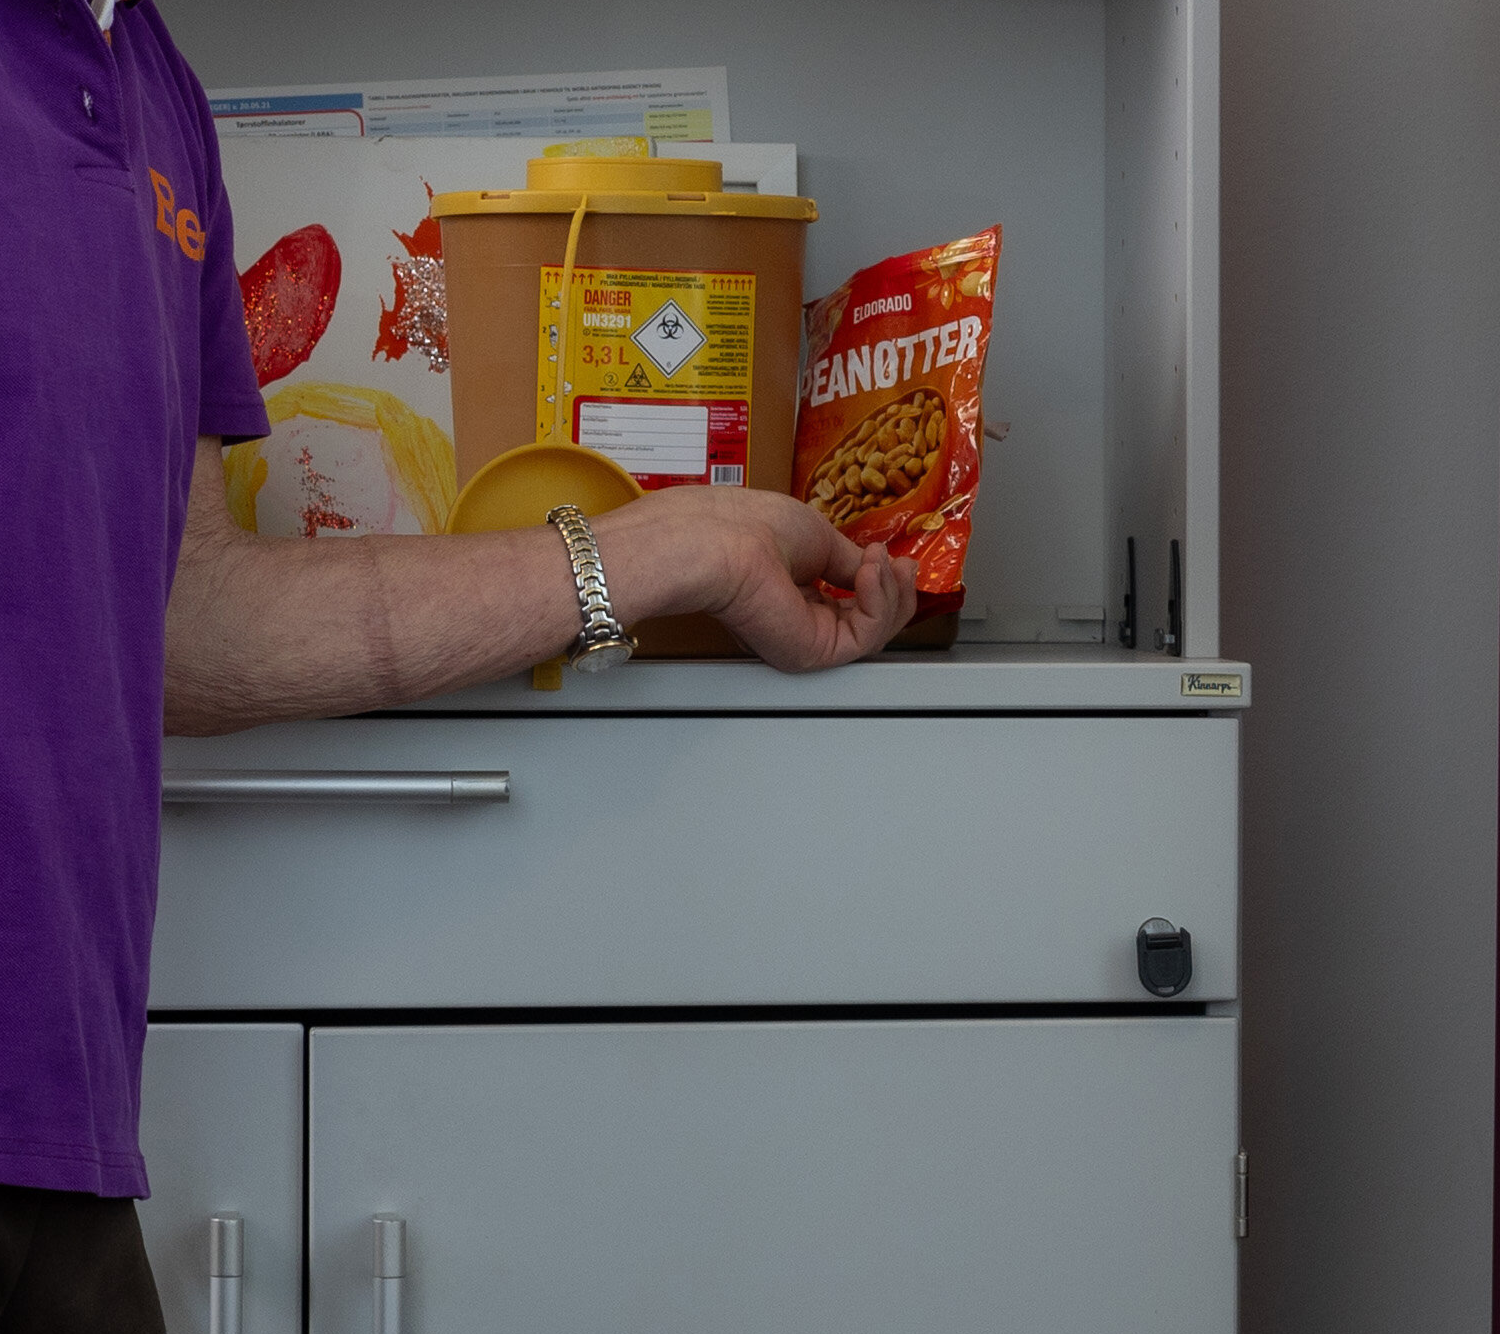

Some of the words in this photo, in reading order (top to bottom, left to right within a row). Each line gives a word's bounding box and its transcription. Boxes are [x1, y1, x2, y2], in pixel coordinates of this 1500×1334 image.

[148, 167, 206, 261] Be
[583, 288, 632, 308] DANGER
[853, 293, 913, 325] ELDORADO
[582, 312, 632, 329] UN3291
[582, 344, 612, 367] 3,3
[618, 345, 630, 365] L
[801, 315, 983, 408] PEANØTTER
